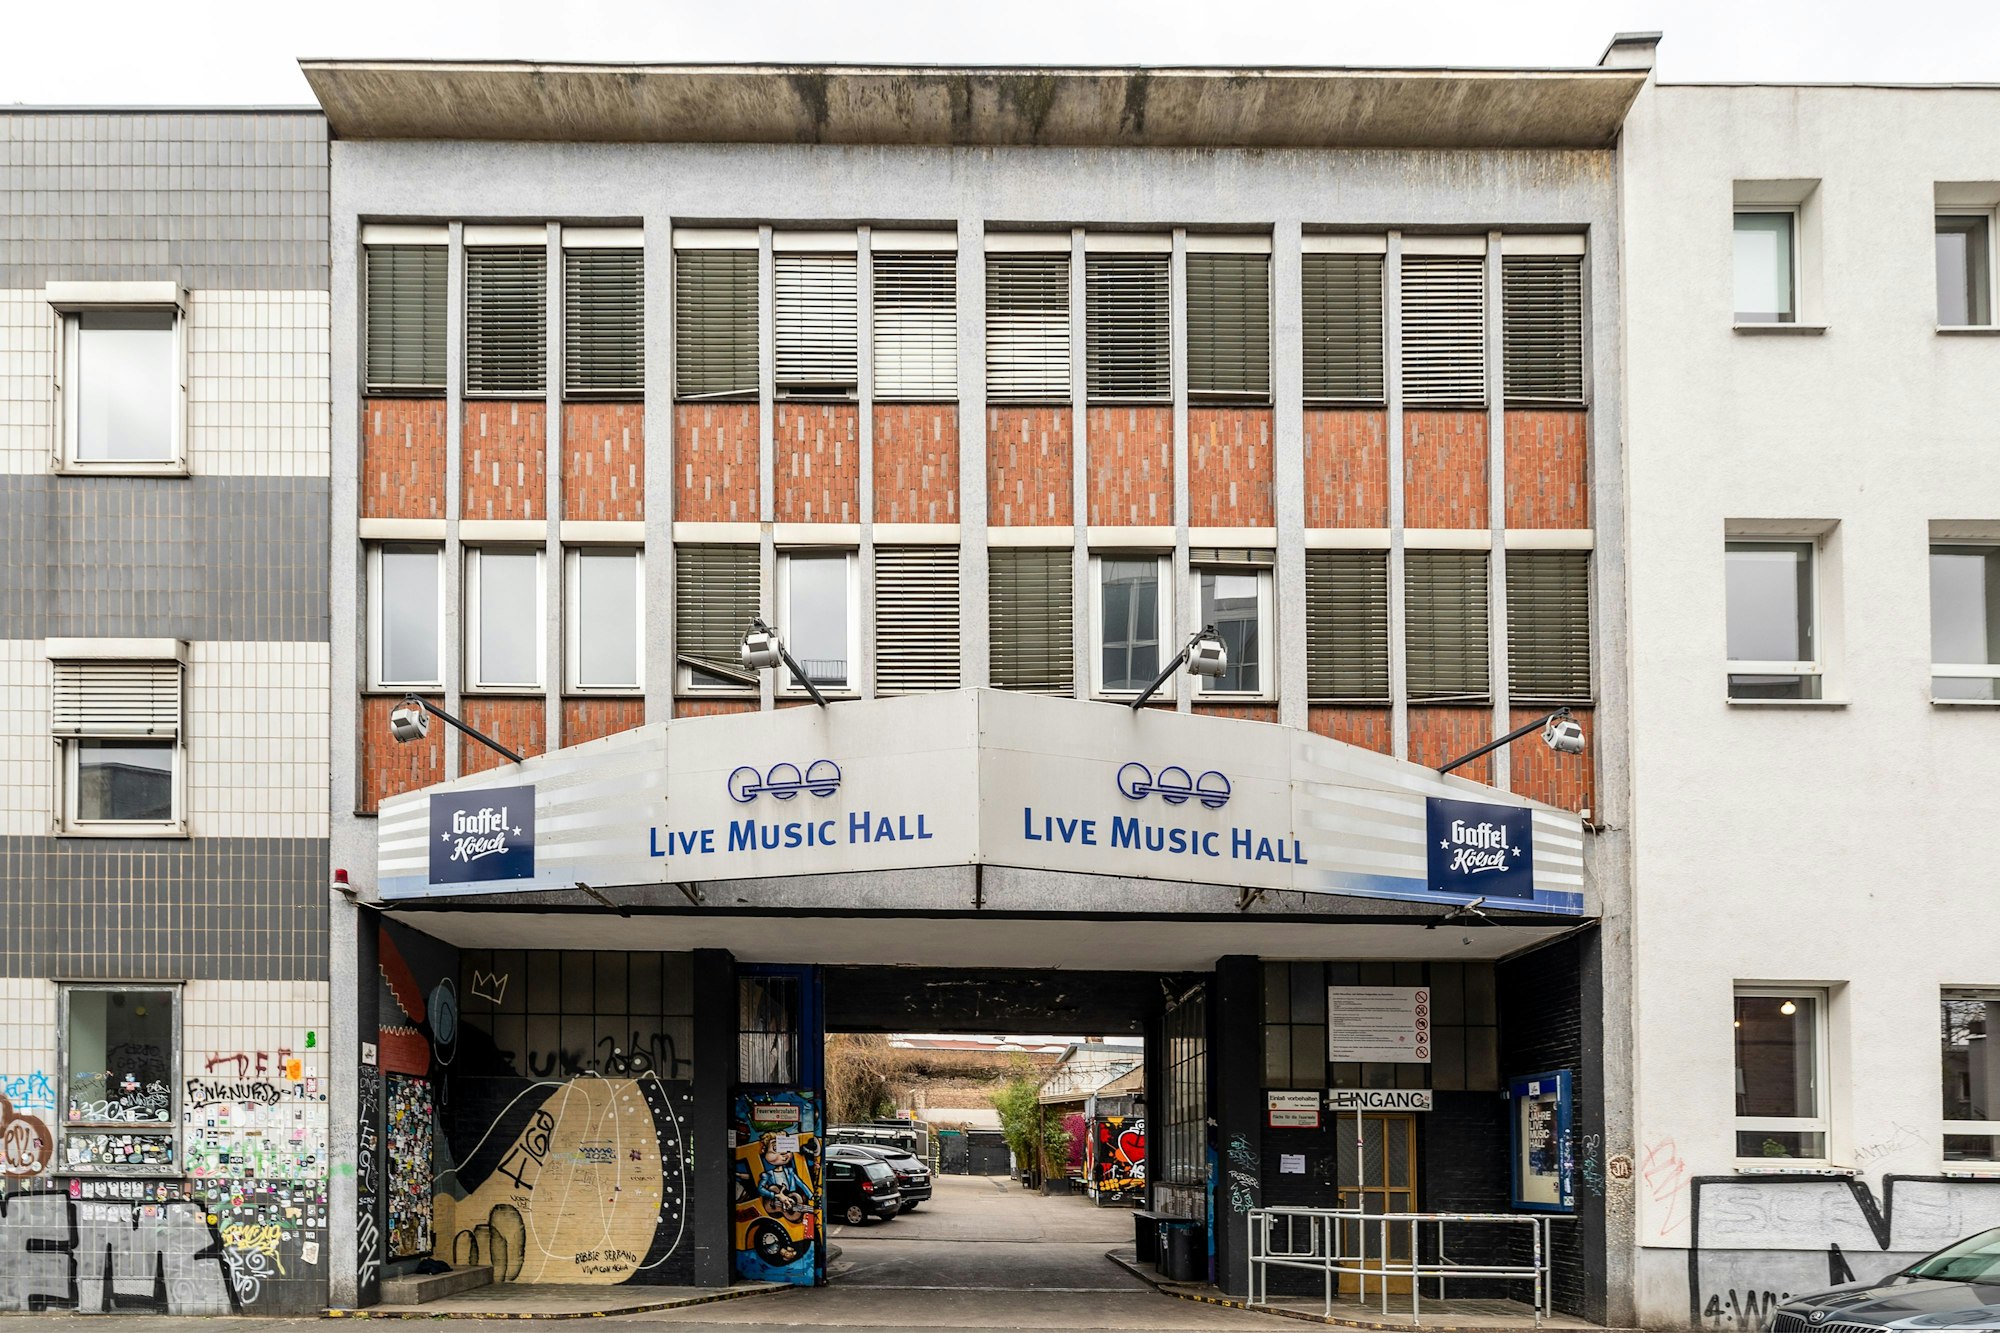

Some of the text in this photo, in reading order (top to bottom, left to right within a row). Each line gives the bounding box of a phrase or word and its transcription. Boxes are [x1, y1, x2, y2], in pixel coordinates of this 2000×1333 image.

[452, 807, 509, 835] Gaffel
[1451, 820, 1509, 849] Gaffel
[450, 833, 508, 862] Kölsch
[1450, 845, 1509, 874] Kölsch
[1337, 1092, 1425, 1108] EINGANG
[756, 1107, 797, 1115] Feuerwehrzufahrt
[1529, 1111, 1552, 1121] JAHRE
[1530, 1130, 1550, 1139] MUSIC
[1530, 1139, 1546, 1148] HALL
[604, 1250, 637, 1262] SERRANO
